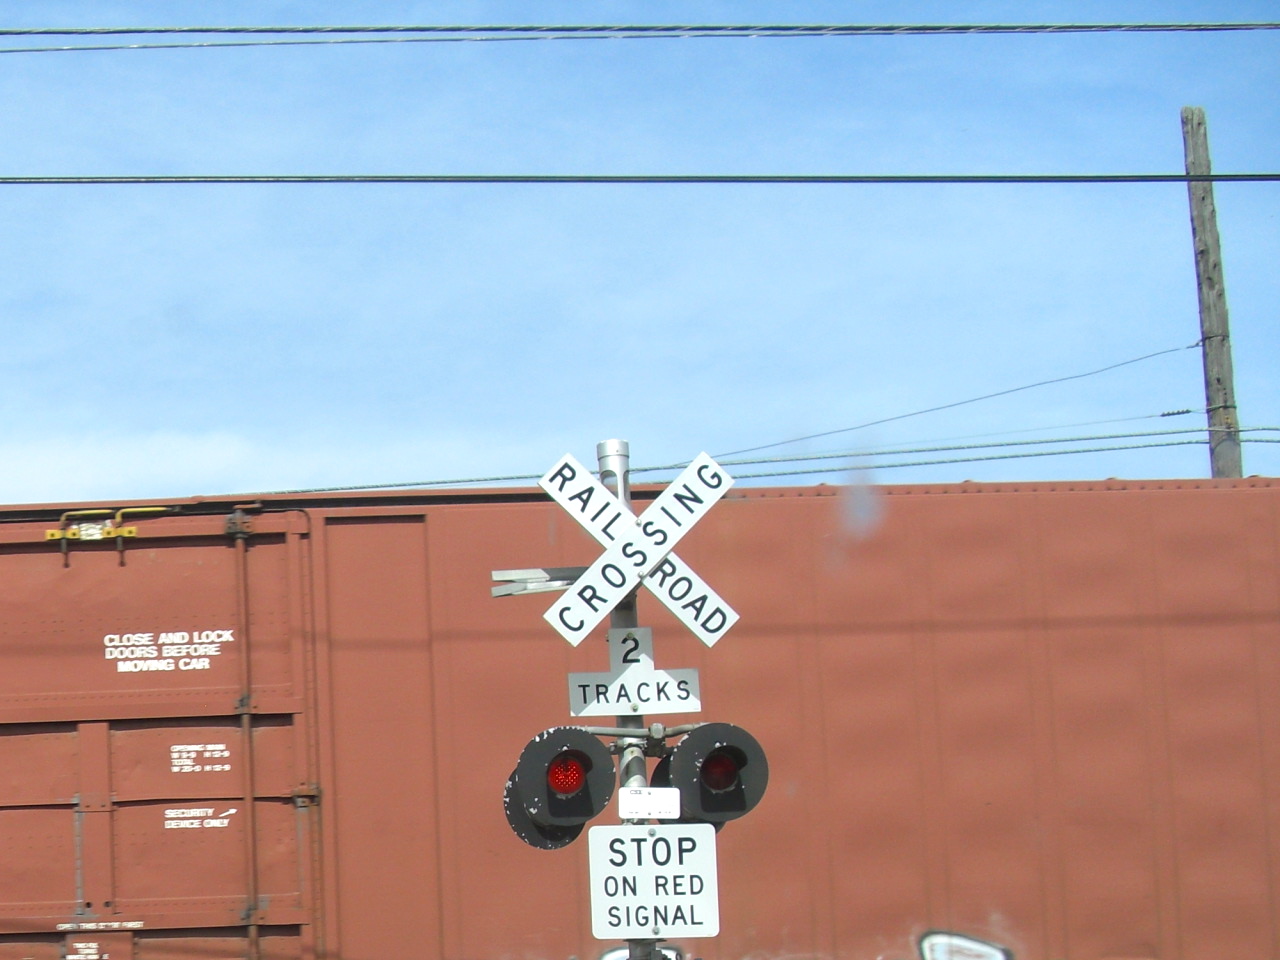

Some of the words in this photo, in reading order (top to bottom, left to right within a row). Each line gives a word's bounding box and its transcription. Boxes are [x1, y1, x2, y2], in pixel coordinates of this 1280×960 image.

[548, 461, 622, 542] RAIL
[649, 556, 728, 635] ROAD
[558, 463, 723, 633] CROSSING
[103, 633, 155, 647] CLOSE
[157, 632, 190, 645] AND
[192, 630, 235, 643] LOCK
[621, 637, 641, 664] 2
[104, 646, 159, 660] DOORS
[161, 644, 222, 657] BEFORE
[116, 659, 176, 673] MOVING
[178, 658, 211, 671] CAR
[578, 679, 691, 705] TRACKS
[608, 836, 698, 867] STOP
[603, 875, 638, 898] ON
[654, 874, 705, 897] RED
[607, 904, 704, 928] SIGNAL
